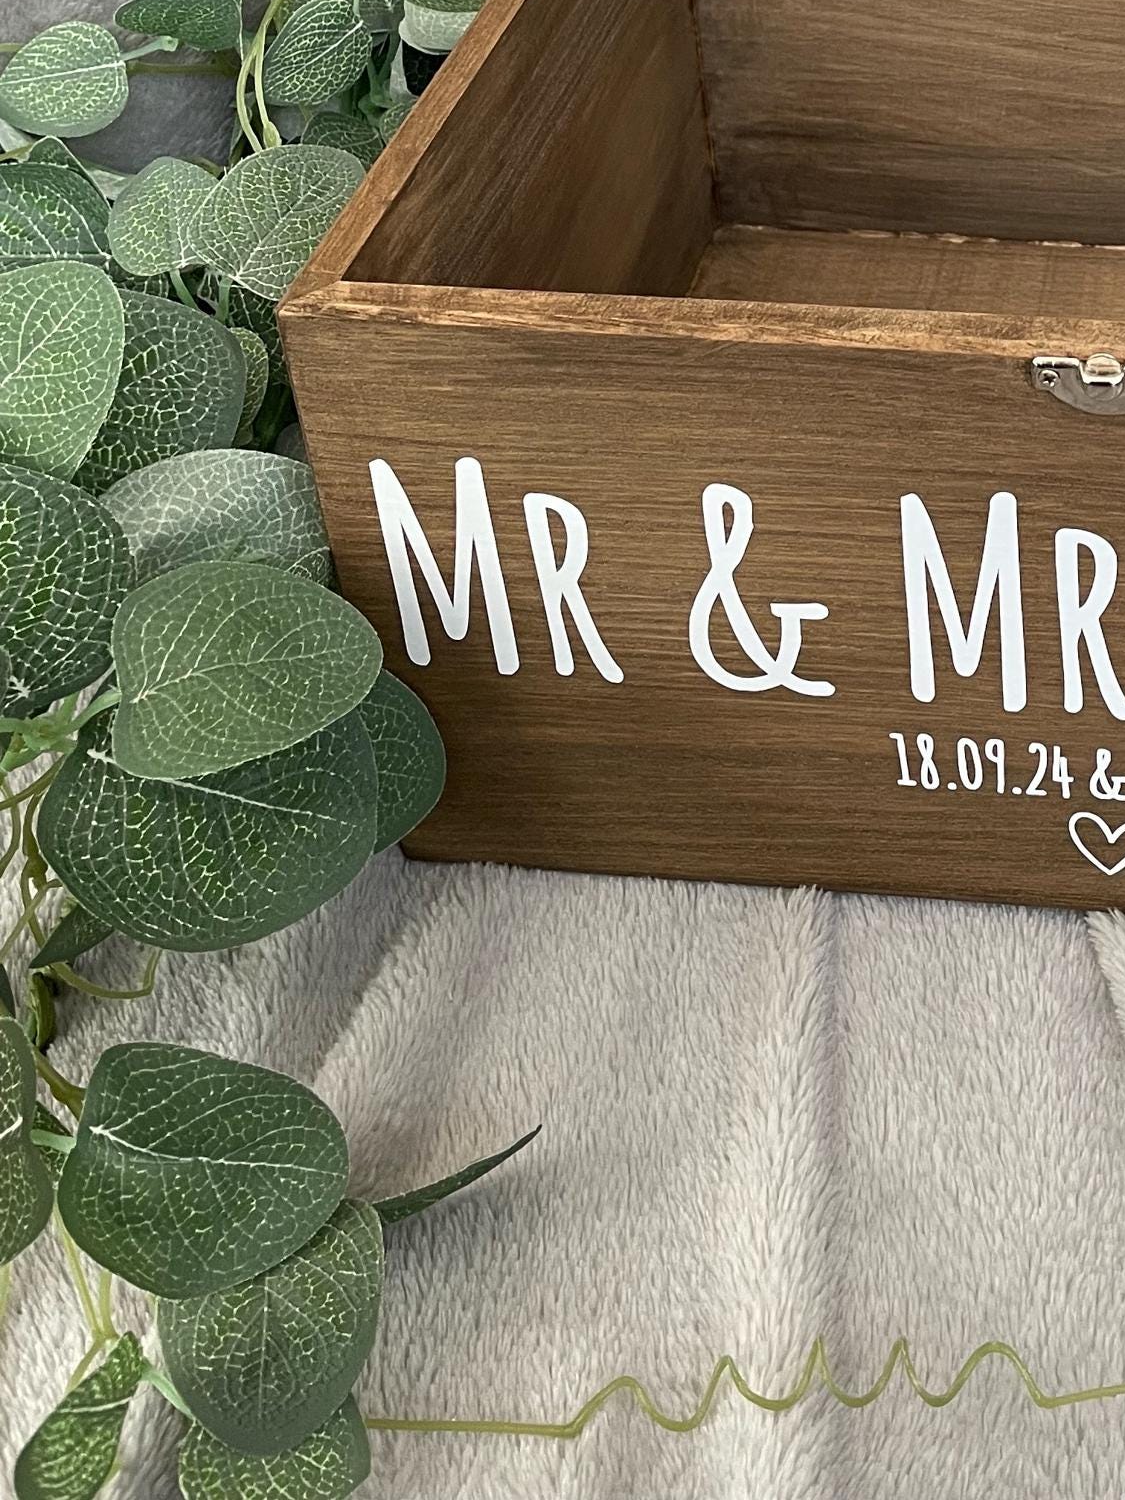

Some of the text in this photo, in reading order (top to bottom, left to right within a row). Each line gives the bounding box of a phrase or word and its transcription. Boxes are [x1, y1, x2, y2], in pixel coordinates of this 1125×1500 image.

[368, 456, 625, 684] MR
[688, 483, 836, 697] &
[889, 732, 1075, 799] 18.09.24
